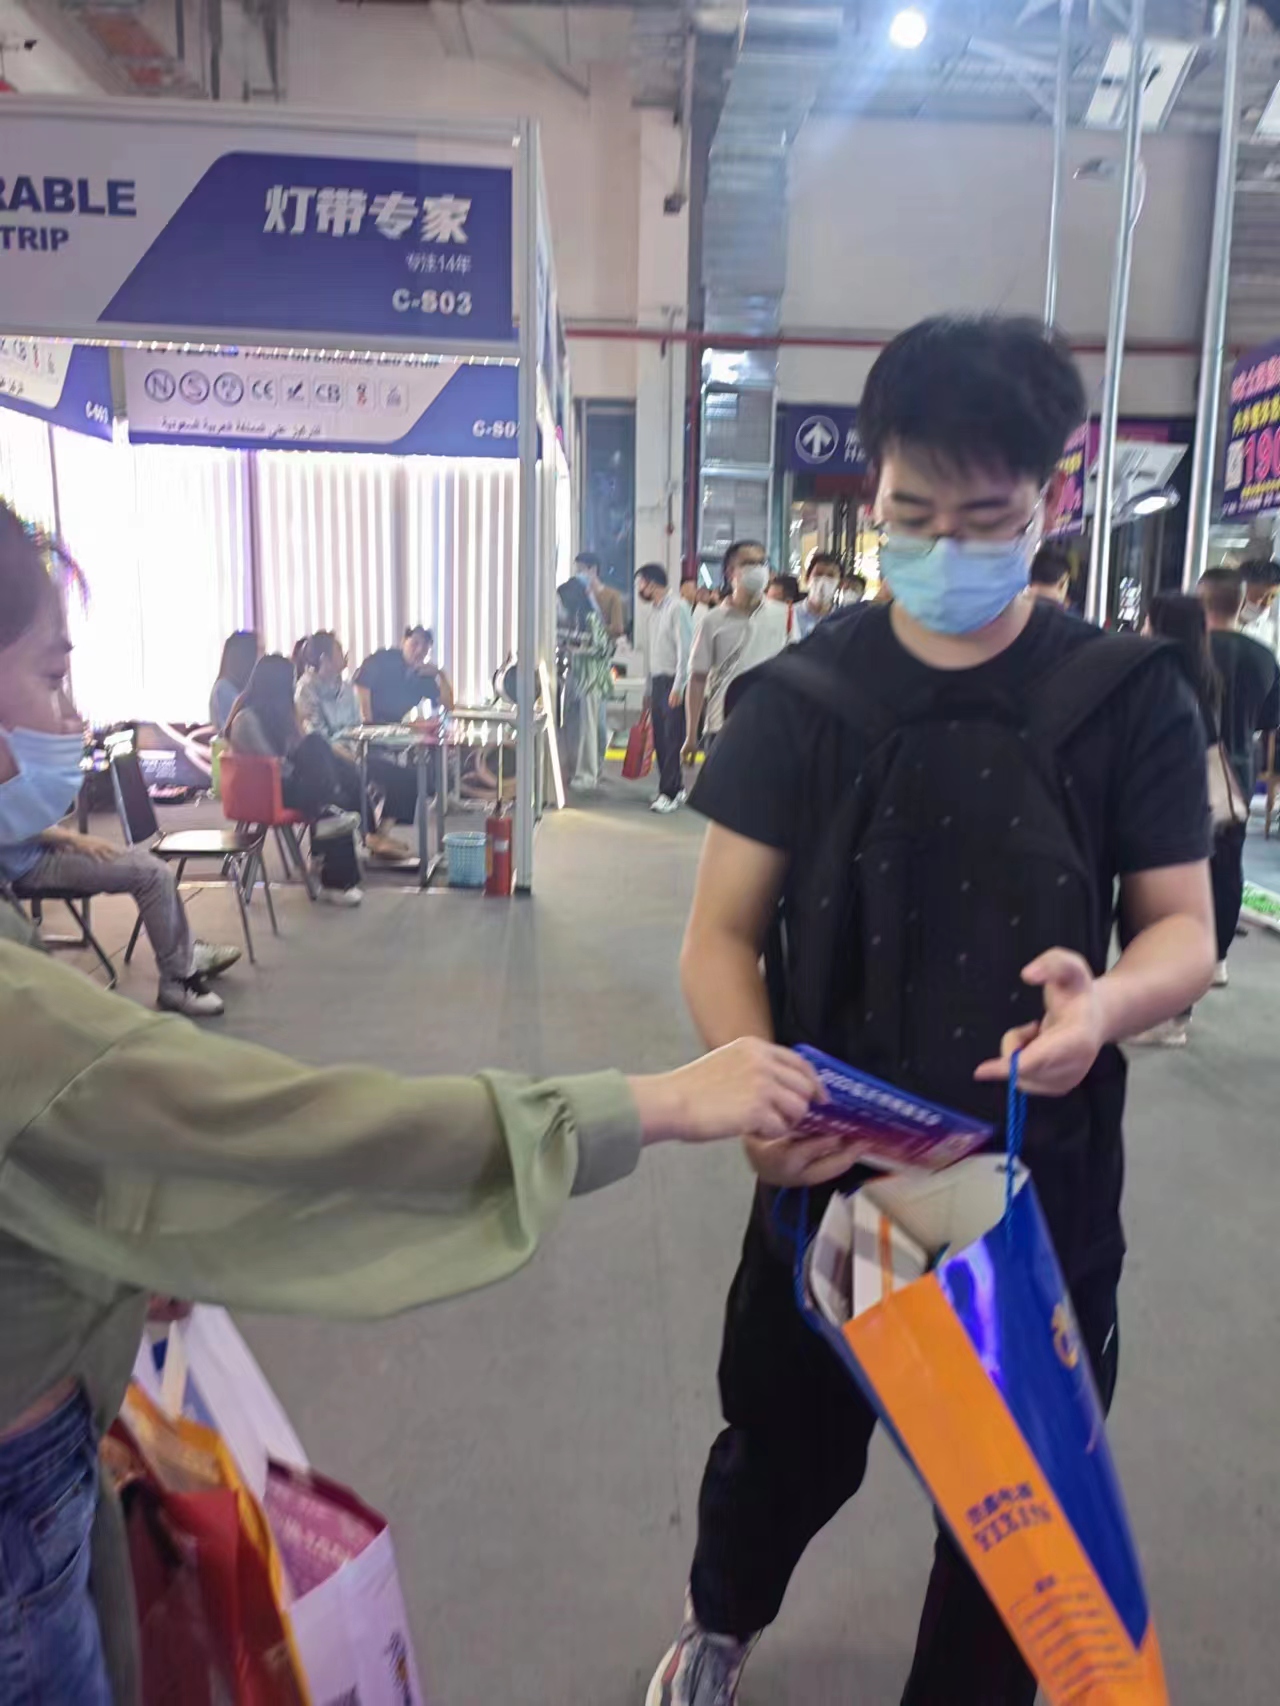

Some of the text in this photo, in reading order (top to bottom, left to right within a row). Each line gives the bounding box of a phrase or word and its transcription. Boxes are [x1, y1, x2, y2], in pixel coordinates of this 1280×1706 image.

[0, 175, 137, 217] ABLE
[262, 184, 473, 243] 灯带专家
[472, 419, 520, 439] C-S0
